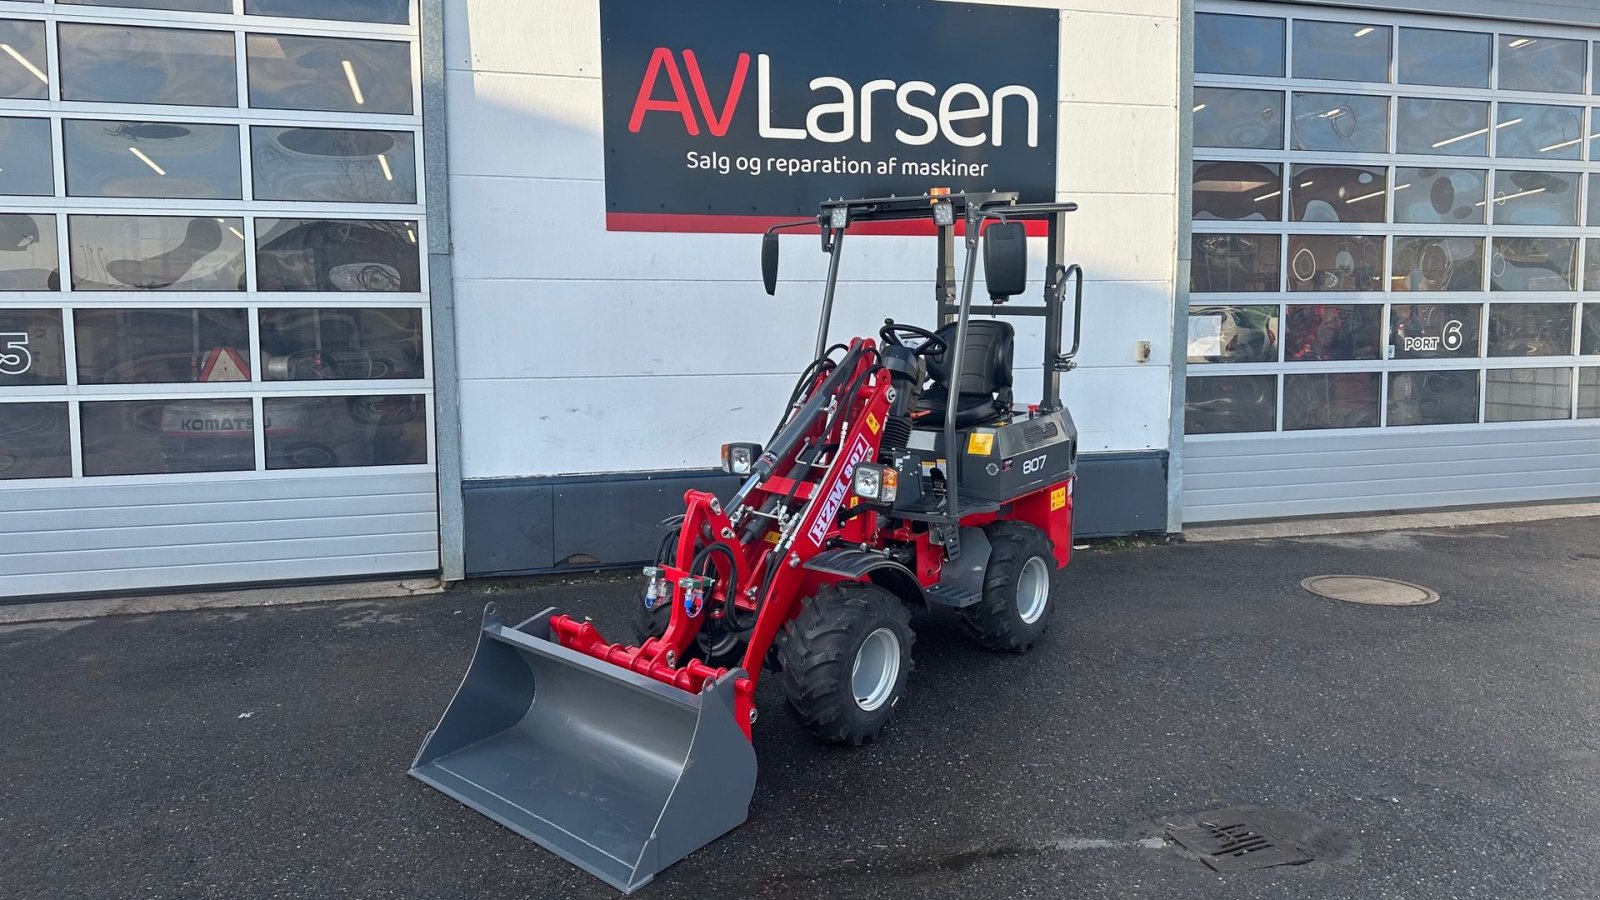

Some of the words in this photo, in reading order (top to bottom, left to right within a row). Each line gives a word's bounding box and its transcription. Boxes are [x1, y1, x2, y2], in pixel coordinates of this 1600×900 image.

[686, 151, 730, 175] Salg
[736, 156, 761, 176] og
[767, 156, 872, 177] reparation
[877, 157, 898, 175] af
[902, 158, 989, 177] maskiner
[1404, 336, 1440, 351] PORT
[1442, 319, 1463, 351] 6
[0, 332, 32, 375] 5
[1022, 454, 1047, 475] 807
[811, 478, 847, 541] HZM
[844, 441, 865, 480] 807
